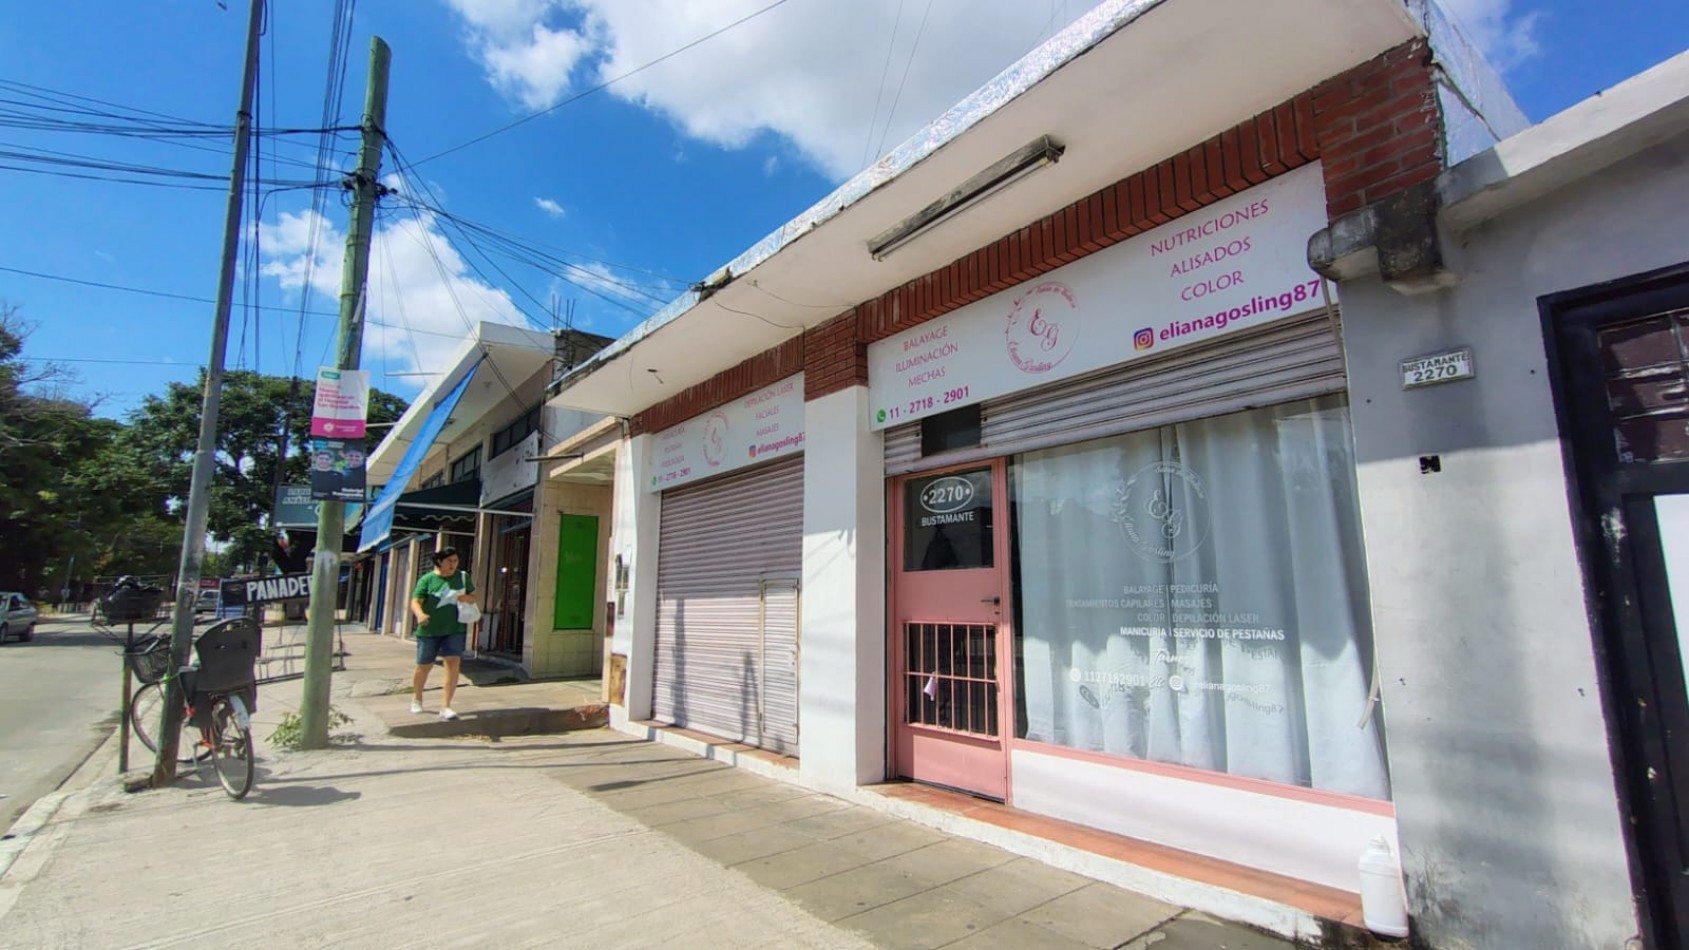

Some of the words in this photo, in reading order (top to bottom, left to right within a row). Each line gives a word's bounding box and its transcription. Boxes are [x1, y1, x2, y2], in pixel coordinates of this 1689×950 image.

[1151, 198, 1269, 257] NUTRICIONES
[1170, 237, 1251, 277] ALISADOS
[1181, 270, 1244, 301] COLOR
[1159, 280, 1320, 341] elianagosling87
[903, 325, 948, 351] BALAYAGE
[895, 342, 958, 373] ILUMINACIÓN
[1402, 354, 1469, 373] BUSTAMANTE
[908, 366, 946, 387] MECHAS
[1413, 364, 1458, 382] 2270
[889, 407, 900, 419] 11
[909, 397, 934, 414] 2718
[943, 386, 970, 405] 2901
[928, 485, 964, 504] 2270
[921, 511, 974, 527] BUSTAMANTE
[1173, 627, 1215, 638] SERVICIO
[1216, 628, 1231, 639] DE
[1232, 627, 1286, 640] PESTAÑAS
